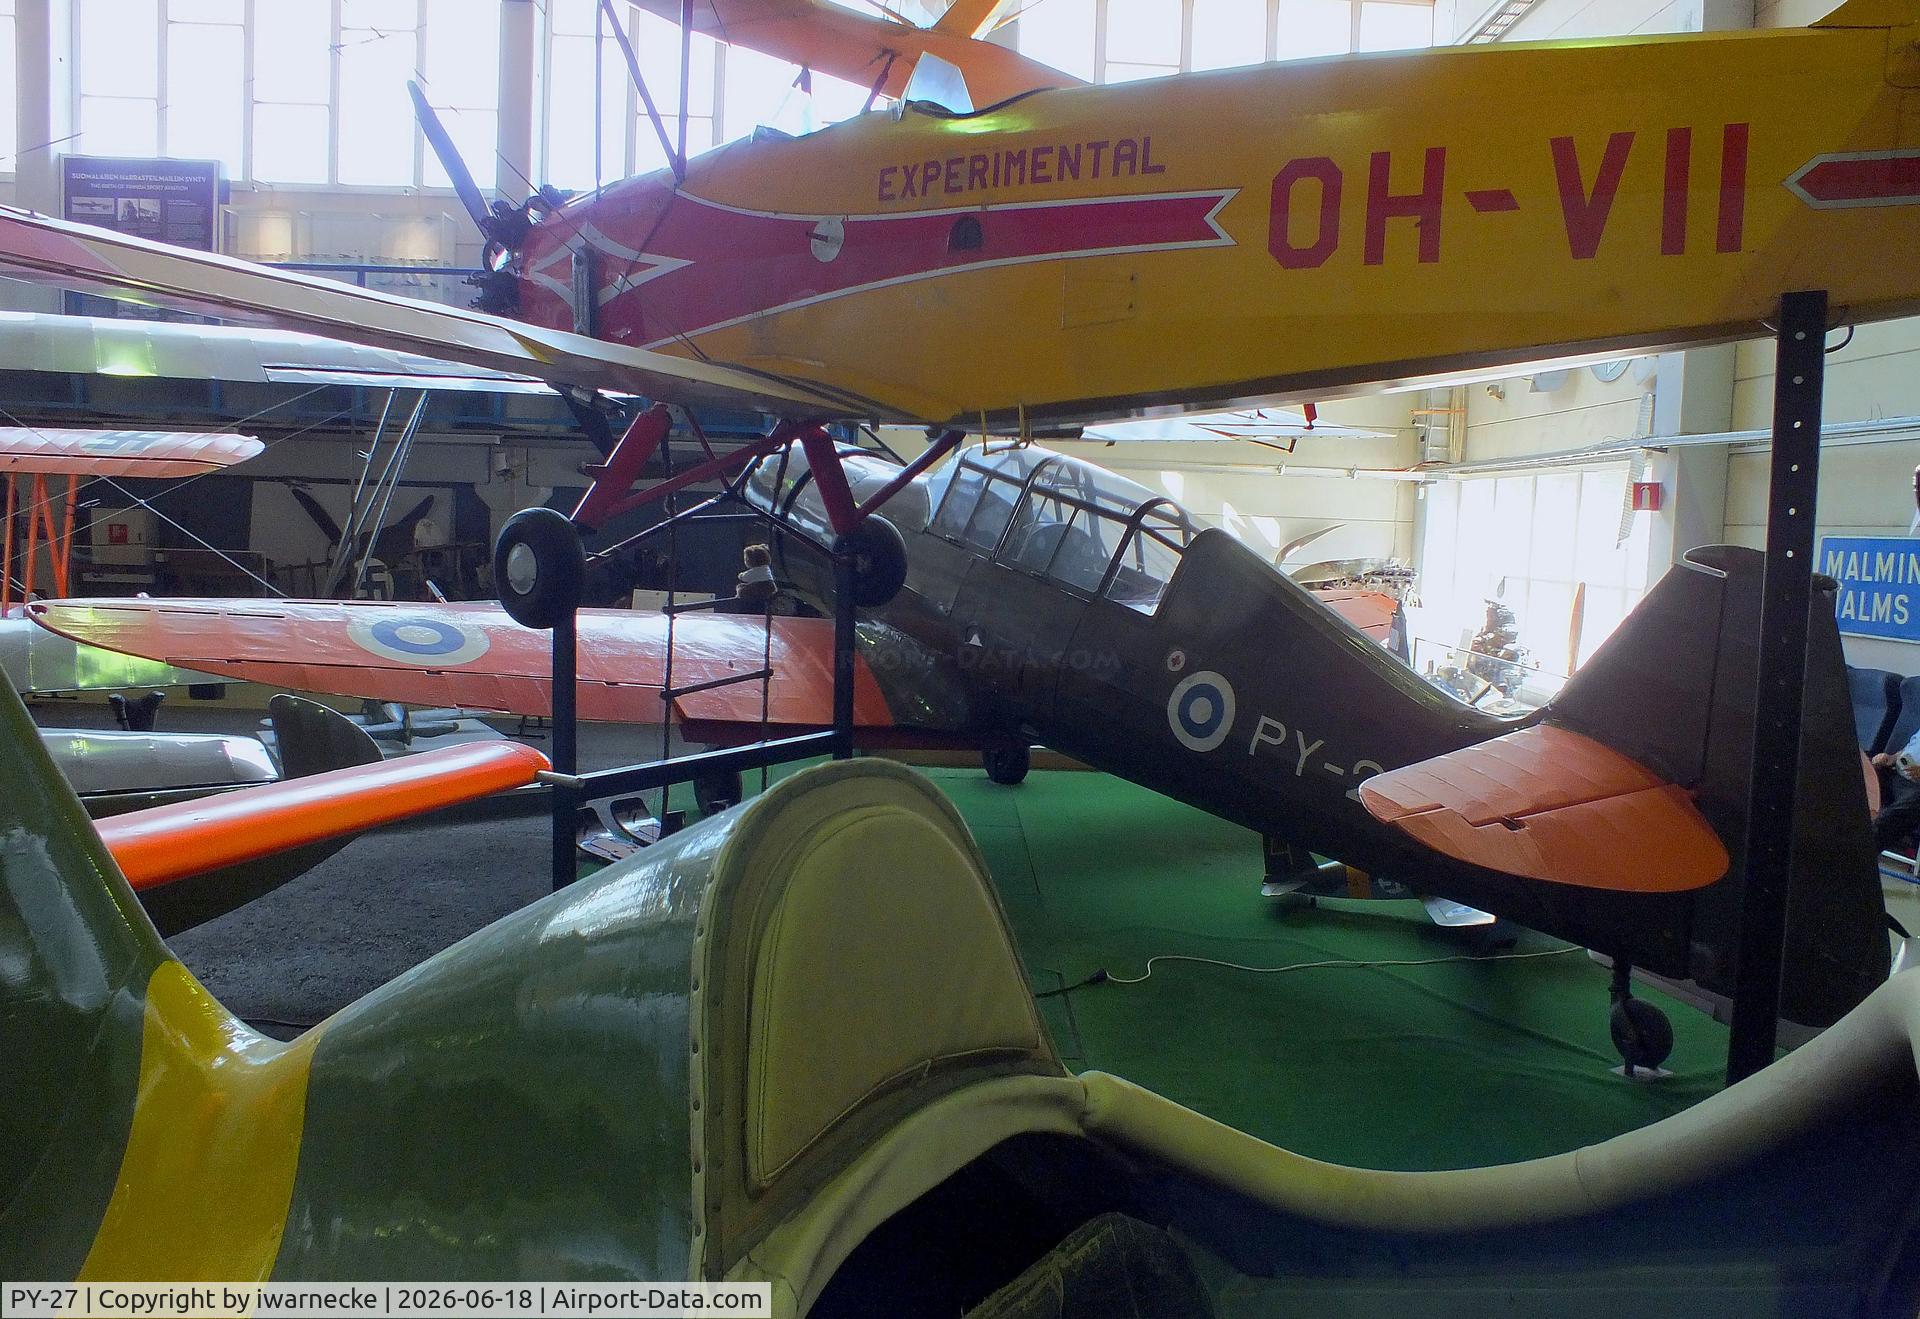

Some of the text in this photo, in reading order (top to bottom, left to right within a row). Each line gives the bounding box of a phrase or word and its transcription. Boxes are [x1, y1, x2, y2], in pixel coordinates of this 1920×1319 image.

[878, 137, 1166, 201] EXPERIMENTAL
[1268, 122, 1750, 269] OH-VII
[1836, 590, 1909, 625] ALMS
